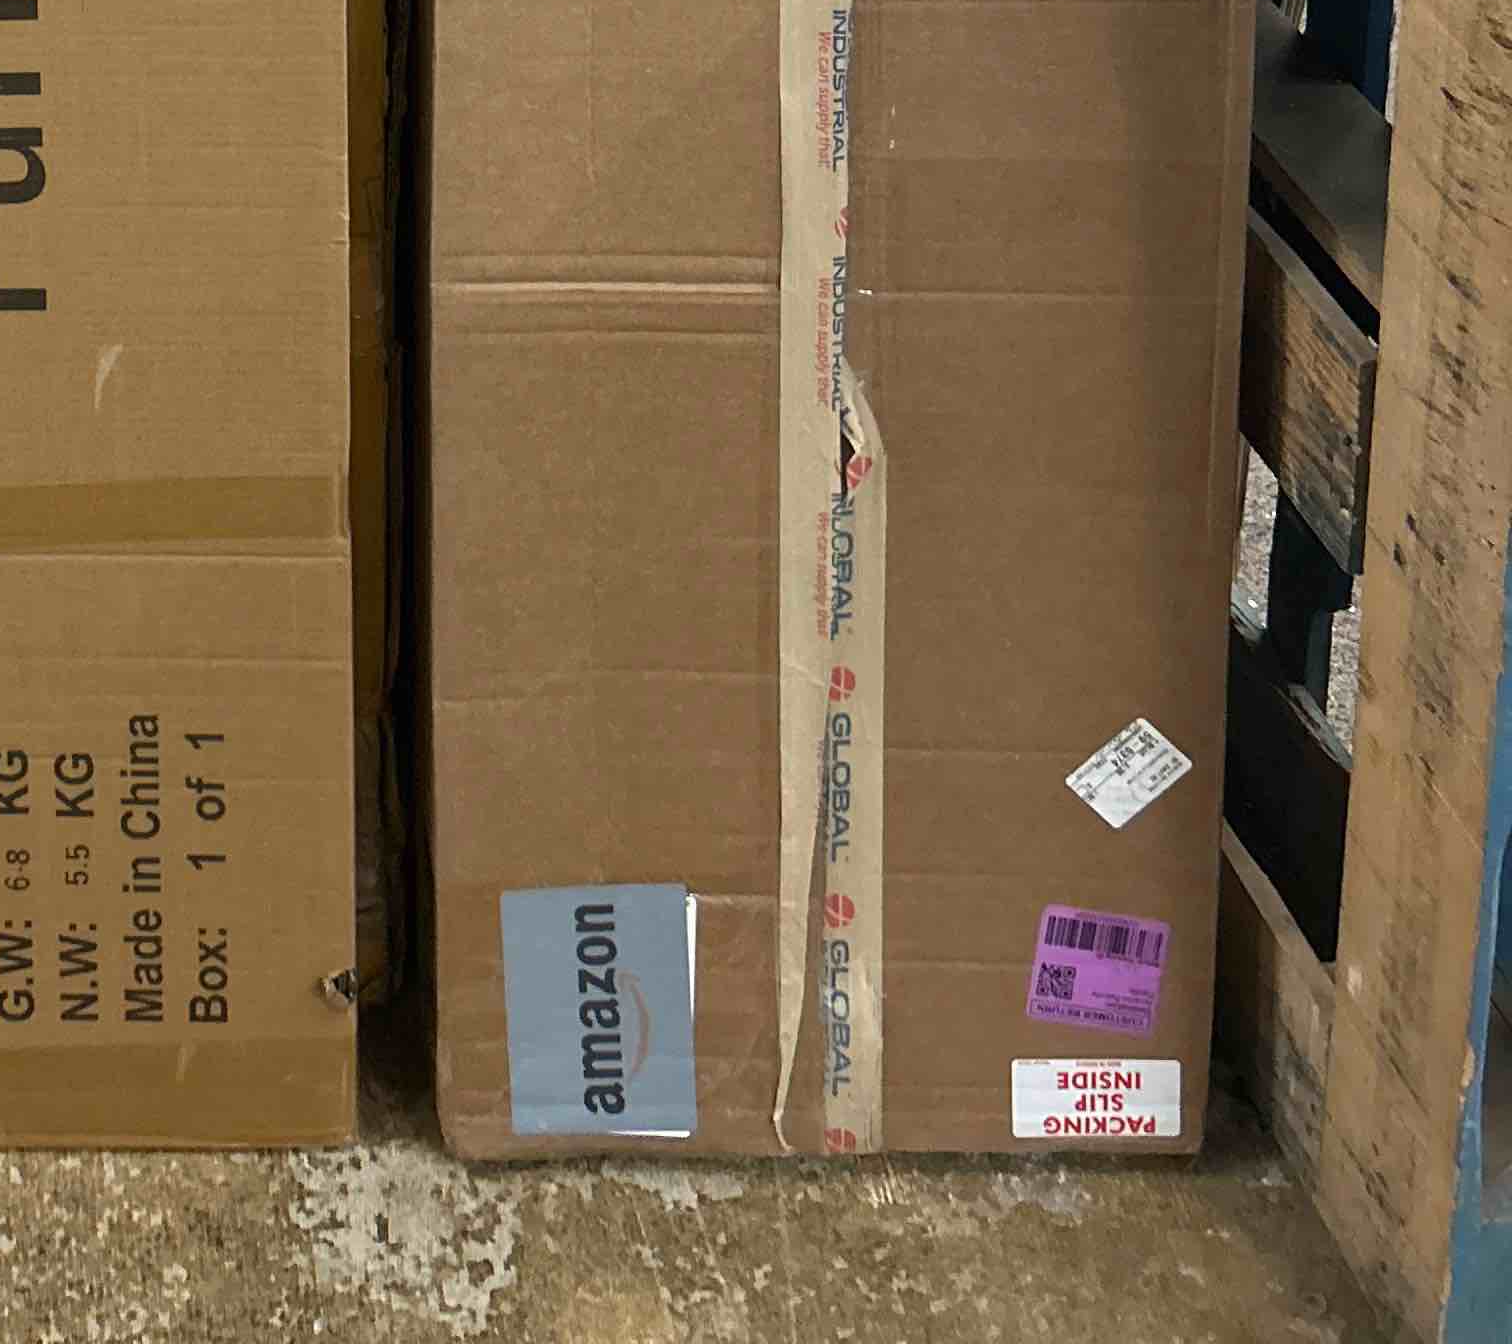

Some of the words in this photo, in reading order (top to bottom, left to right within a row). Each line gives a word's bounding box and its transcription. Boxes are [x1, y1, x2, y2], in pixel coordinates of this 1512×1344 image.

[832, 9, 847, 172] INDUSTRIAL
[185, 733, 224, 748] 1
[54, 752, 94, 818] KG
[120, 714, 161, 840] China
[185, 777, 227, 821] of
[832, 712, 851, 863] GLOBAL
[65, 844, 89, 886] 5.5
[123, 856, 161, 893] in
[189, 853, 226, 870] 1
[59, 922, 97, 1022] N.W:
[124, 909, 163, 1022] Made
[189, 927, 229, 1025] Box:
[576, 902, 626, 1115] amazon
[830, 940, 851, 1097] GLOBAL
[1057, 1071, 1141, 1091] INSIDE
[1075, 1094, 1124, 1112] SLIP
[1043, 1116, 1156, 1136] PACKING
